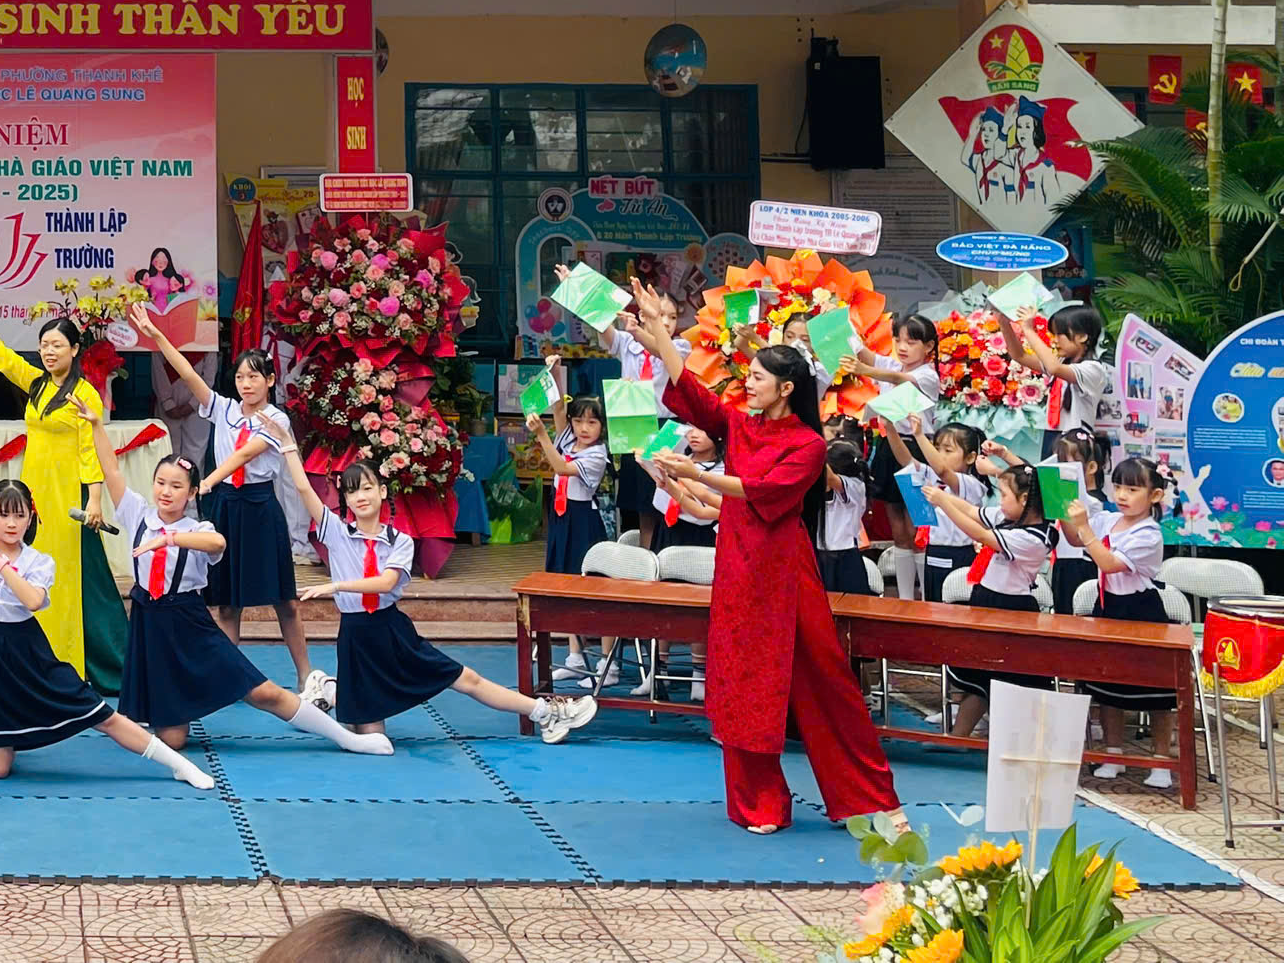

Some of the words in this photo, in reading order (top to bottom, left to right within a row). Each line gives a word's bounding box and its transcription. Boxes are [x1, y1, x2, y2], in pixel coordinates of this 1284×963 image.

[1, 66, 68, 83] PHƯỜNG
[72, 69, 127, 83] THANH
[131, 67, 164, 83] KHÊ
[16, 85, 35, 101] LÊ
[40, 88, 96, 103] QUANG
[100, 88, 146, 101] SUNG
[346, 76, 365, 107] HỌC
[346, 126, 367, 150] SINH
[31, 155, 82, 178] GIÁO
[90, 156, 135, 181] VIỆT
[141, 159, 193, 178] NAM
[17, 184, 79, 203] 2025)
[45, 208, 96, 233] THÀNH
[99, 208, 127, 237] LẬP
[54, 243, 115, 269] TRƯỜNG
